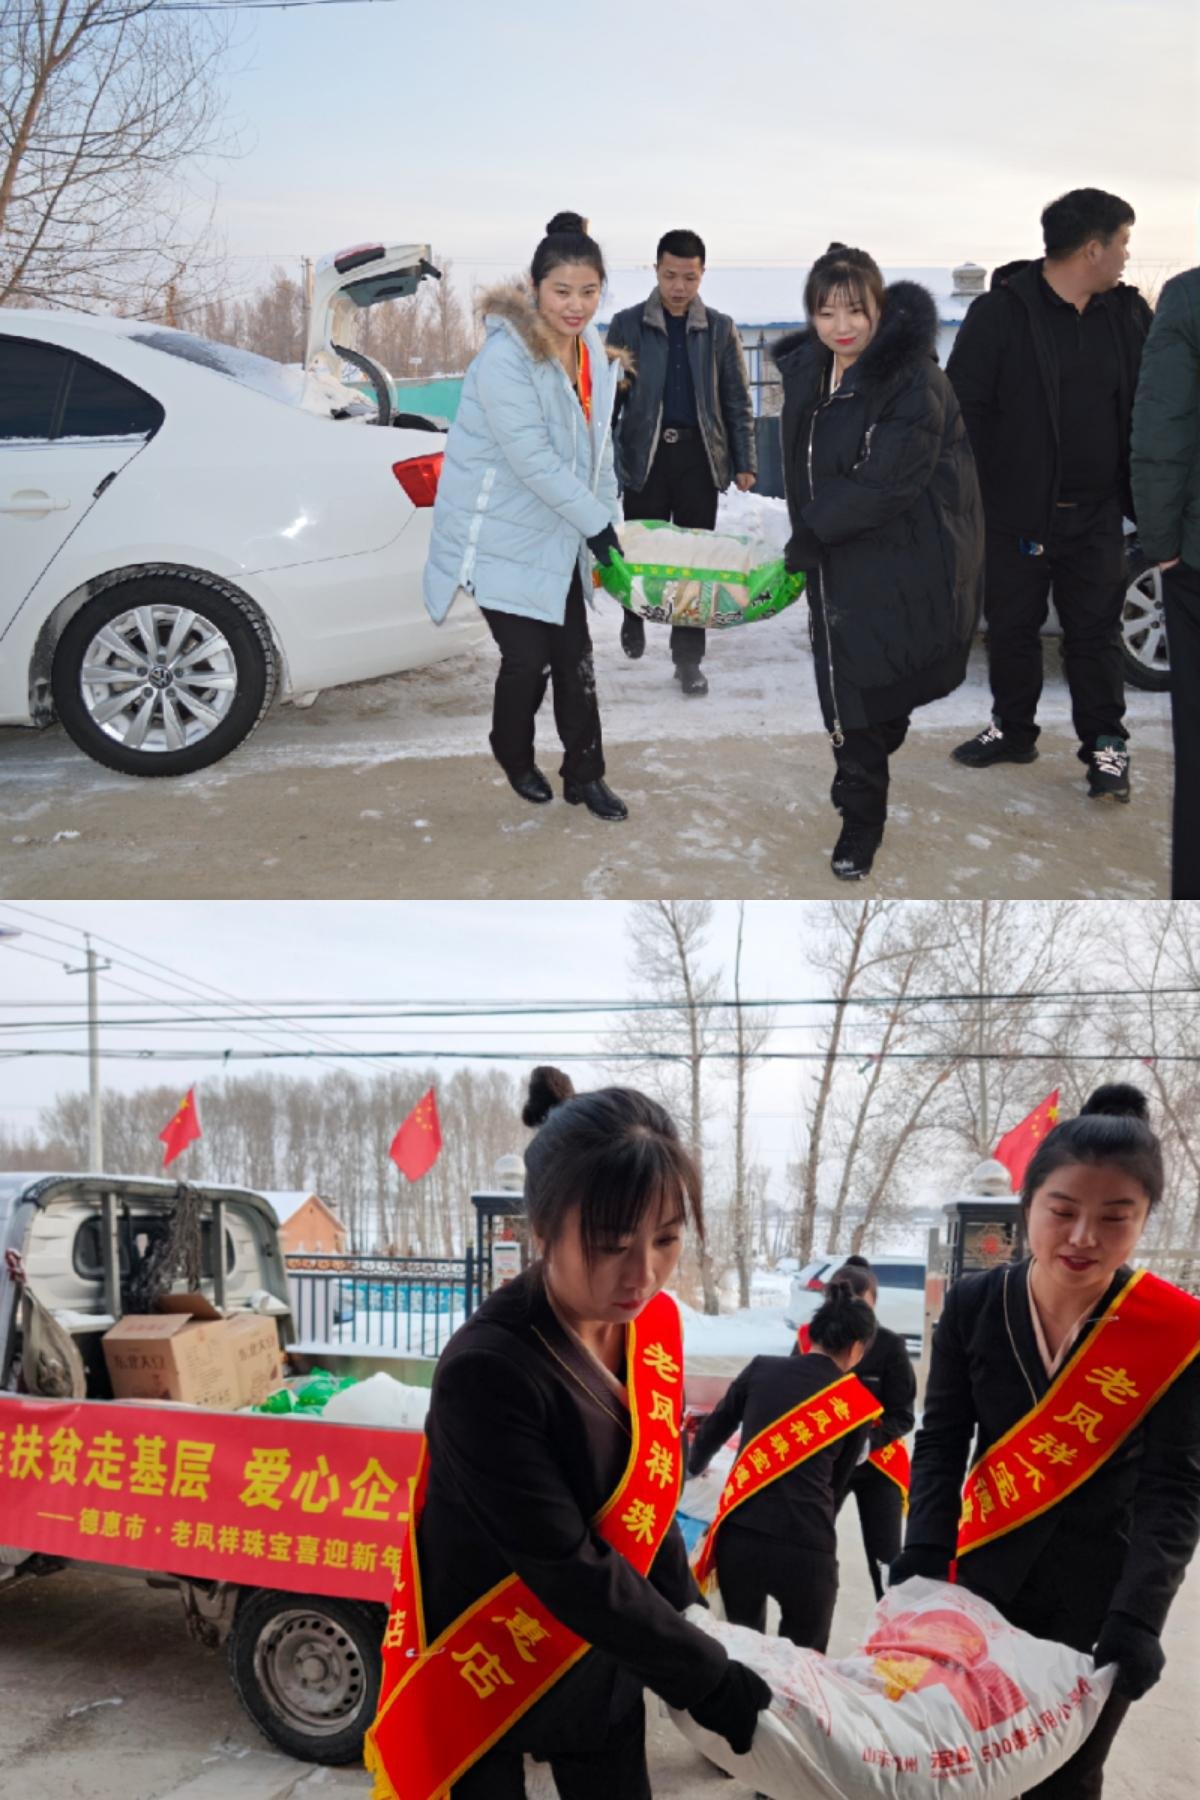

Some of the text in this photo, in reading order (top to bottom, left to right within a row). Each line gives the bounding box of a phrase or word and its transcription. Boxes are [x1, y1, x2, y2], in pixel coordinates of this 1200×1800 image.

[0, 1423, 216, 1502] 扶贫走基层
[620, 1342, 681, 1546] 老凤祥珠
